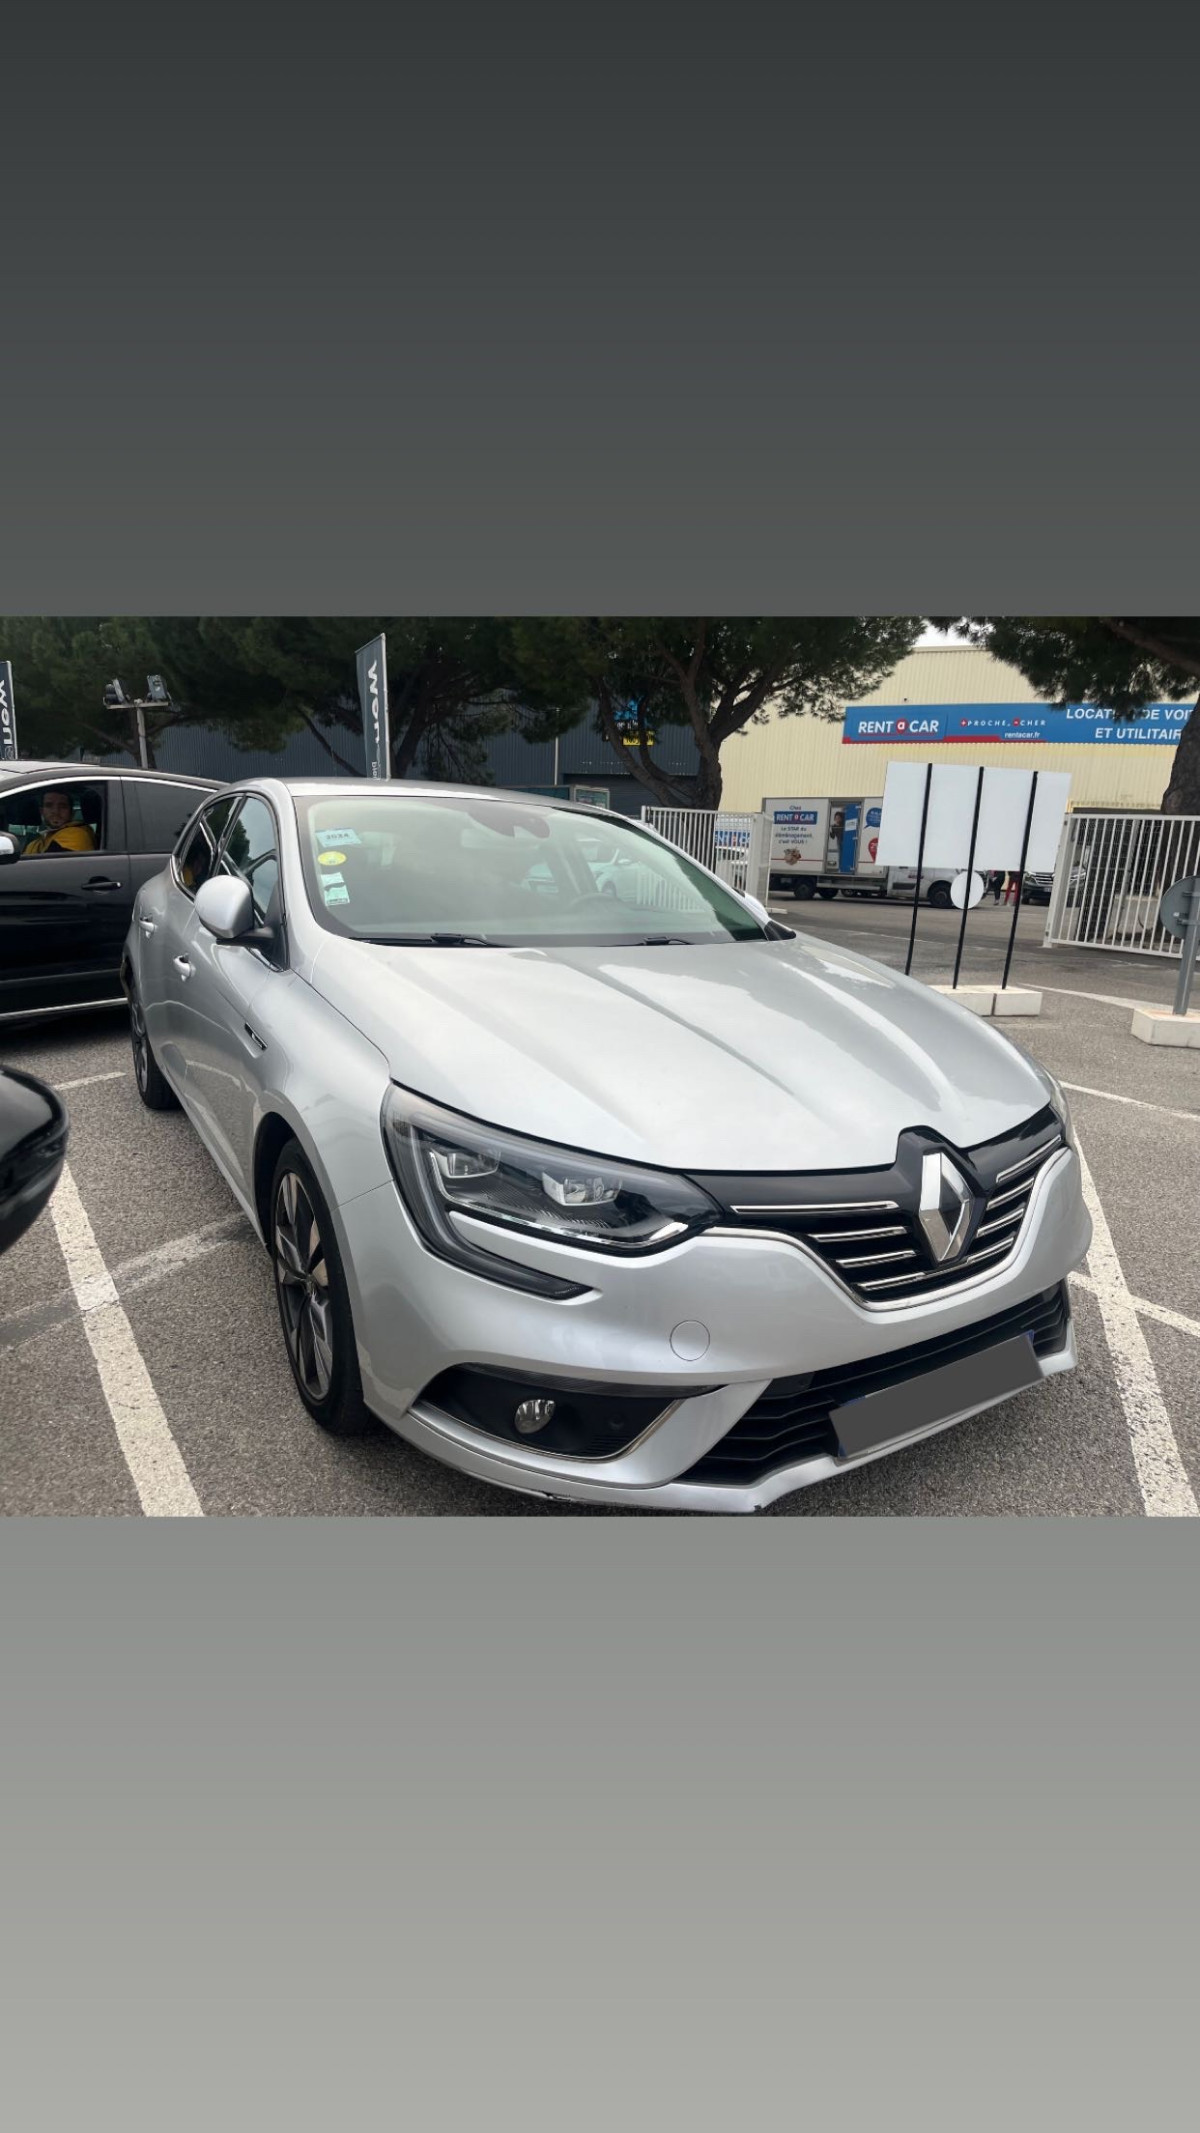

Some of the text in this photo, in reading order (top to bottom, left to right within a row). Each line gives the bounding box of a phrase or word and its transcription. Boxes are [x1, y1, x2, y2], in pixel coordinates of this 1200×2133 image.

[857, 720, 894, 734] RENT
[909, 719, 940, 733] CAR
[1004, 731, 1041, 739] rentacar.fr
[1094, 727, 1113, 739] ET
[776, 813, 793, 821] RENT
[800, 813, 815, 821] CAR
